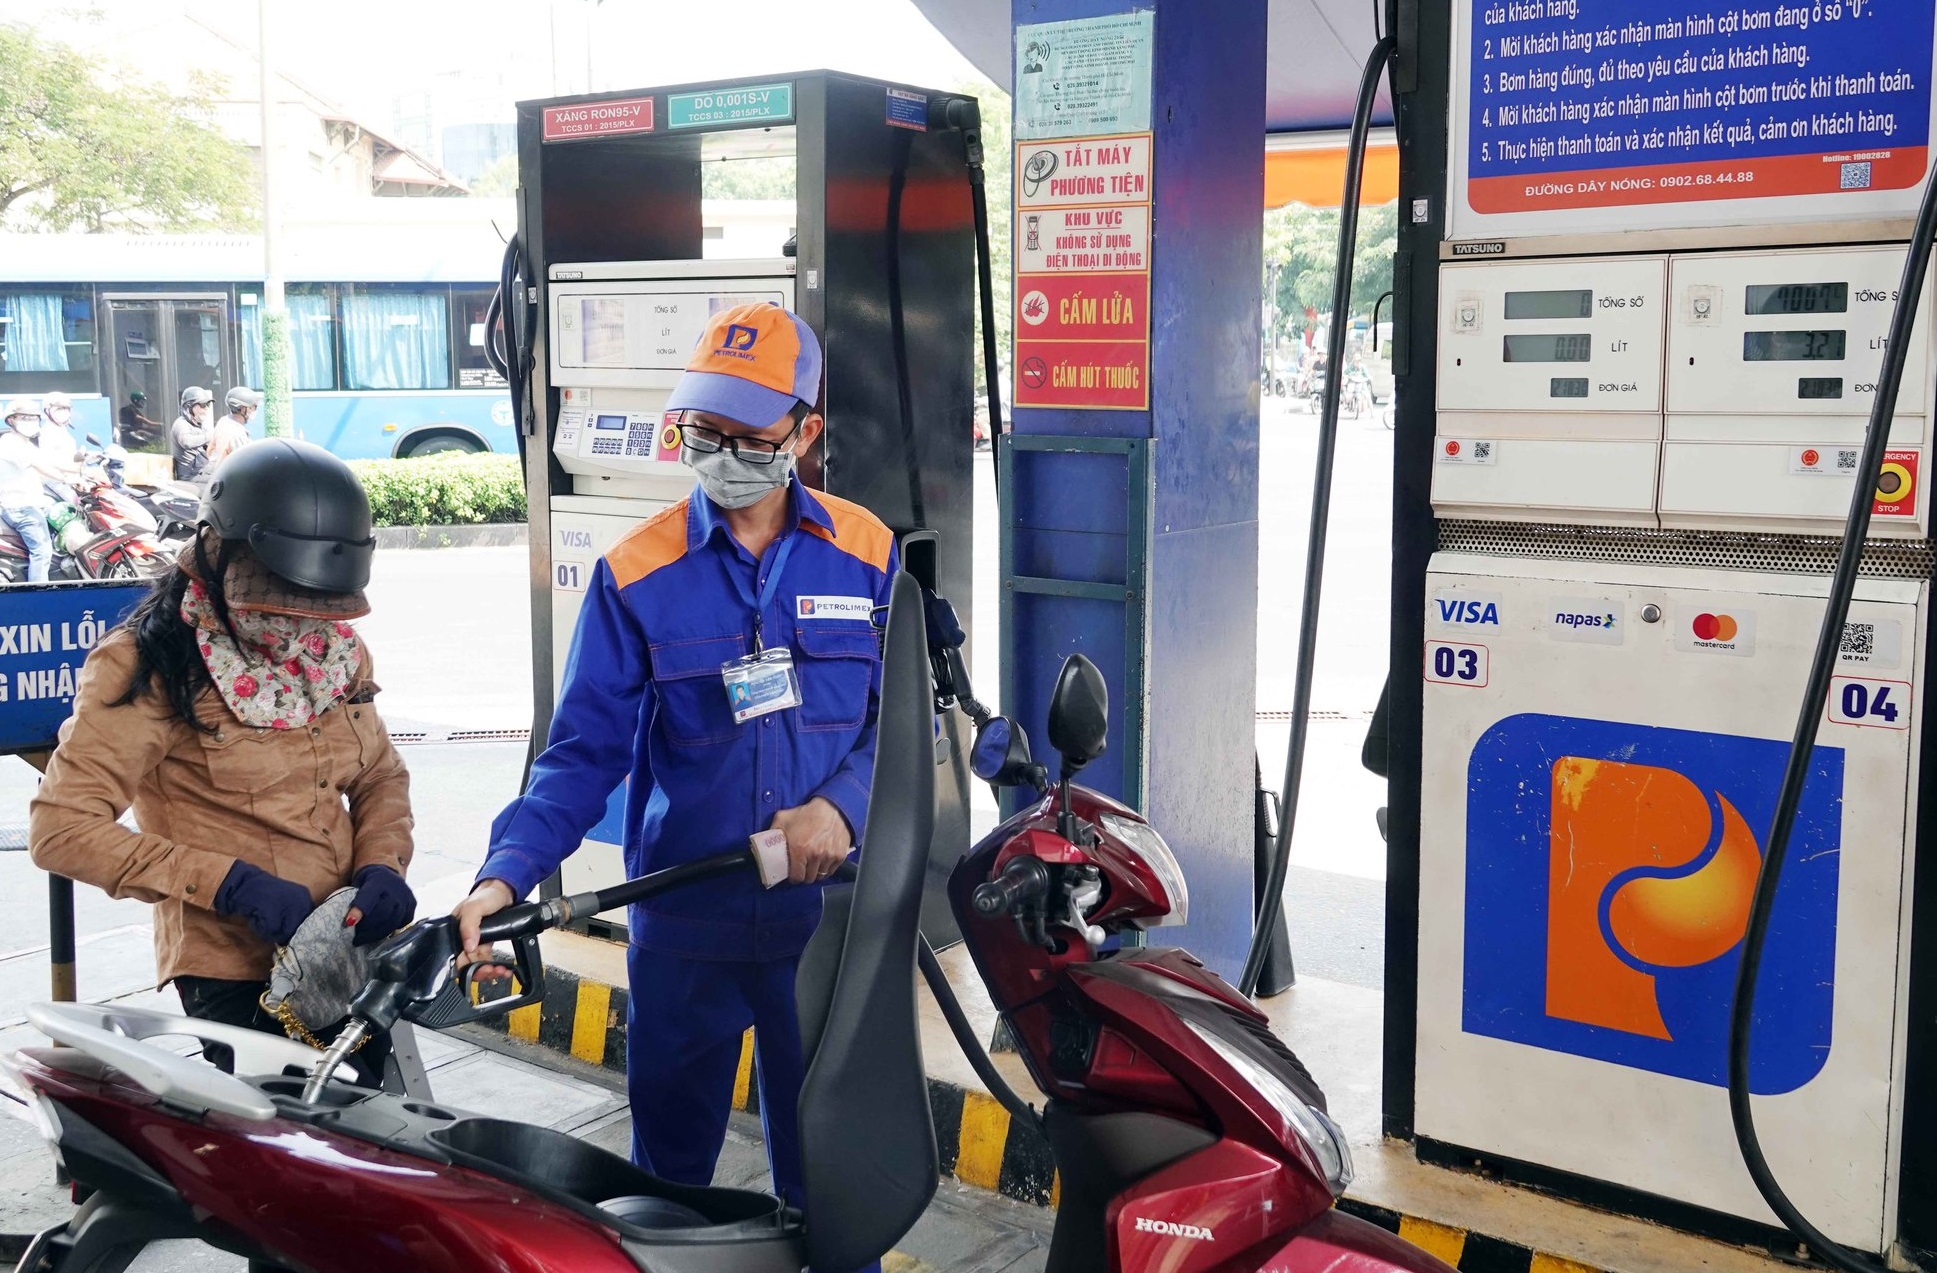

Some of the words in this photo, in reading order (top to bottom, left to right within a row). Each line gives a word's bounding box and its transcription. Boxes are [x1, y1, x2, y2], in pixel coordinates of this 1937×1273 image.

[1485, 2, 1505, 25] của
[1509, 0, 1543, 22] khách
[1484, 39, 1494, 60] 2.
[1500, 36, 1520, 58] Mời
[1524, 31, 1558, 55] khách
[1562, 29, 1592, 53] hàng
[1596, 25, 1617, 48] xác
[1620, 21, 1650, 48] nhận
[1655, 18, 1682, 40] màn
[1686, 13, 1714, 37] hình
[1718, 11, 1738, 37] cột
[1742, 10, 1770, 31] bơm
[1775, 5, 1809, 30] đang
[1484, 74, 1494, 94] 3.
[1500, 72, 1526, 92] Bơm
[1529, 68, 1558, 92] hàng
[1561, 64, 1595, 88] đúng,
[1599, 59, 1614, 82] đủ
[1618, 59, 1644, 80] theo
[1648, 56, 1670, 82] yêu
[1674, 50, 1698, 74] cầu
[1701, 48, 1724, 72] của
[1728, 44, 1768, 69] khách
[1772, 42, 1810, 67] hàng.
[694, 98, 713, 109] DO
[716, 91, 770, 108] 0,001S-V
[1482, 108, 1492, 128] 4.
[1499, 105, 1519, 127] Mời
[1522, 102, 1557, 125] khách
[1560, 100, 1590, 124] hàng
[1594, 96, 1615, 118] xác
[1618, 93, 1648, 119] nhận
[1652, 90, 1680, 112] màn
[1684, 87, 1712, 109] hình
[1716, 86, 1736, 111] cột
[1740, 84, 1768, 105] bơm
[1772, 78, 1806, 102] trước
[1810, 76, 1831, 98] khi
[1836, 73, 1876, 96] thanh
[1880, 68, 1915, 92] toán.
[556, 110, 588, 123] XĂNG
[592, 106, 641, 120] RON95-V
[688, 112, 712, 122] TCCS
[731, 107, 770, 118] 2015/PLX
[562, 125, 582, 133] TCCS
[600, 120, 635, 130] 2015/PLX
[1482, 142, 1492, 162] 5.
[1499, 140, 1526, 164] Thực
[1530, 137, 1554, 162] hiện
[1558, 134, 1592, 156] thanh
[1595, 130, 1621, 152] toán
[1625, 129, 1639, 151] và
[1642, 127, 1664, 150] xác
[1668, 124, 1700, 150] nhận
[1704, 120, 1724, 145] kết
[1727, 118, 1755, 148] quả,
[1759, 116, 1787, 140] cảm
[1791, 121, 1808, 138] ơn
[1812, 111, 1854, 136] khách
[1858, 109, 1898, 136] hàng.
[1065, 144, 1092, 167] TẮT
[1098, 144, 1132, 166] MÁY
[1822, 155, 1852, 163] Hotline:
[1853, 151, 1890, 162] 19002828
[1050, 175, 1105, 196] PHƯƠNG
[1111, 172, 1144, 196] TIỆN
[1525, 180, 1574, 196] ĐƯỜNG
[1578, 179, 1606, 194] DÂY
[1610, 176, 1656, 190] NÓNG:
[1660, 172, 1754, 188] 0902.68.44.88
[1065, 213, 1091, 226] KHU
[1096, 210, 1122, 228] VỰC
[1056, 234, 1086, 250] KHÔNG
[1090, 232, 1102, 248] SỬ
[1106, 234, 1132, 250] DỤNG
[1455, 244, 1503, 254] TATSUNO
[1046, 252, 1068, 270] ĐIỆN
[1072, 254, 1100, 270] THOẠI
[1103, 254, 1112, 266] DI
[1116, 250, 1142, 269] ĐỘNG
[1598, 296, 1626, 308] TỔNG
[1630, 295, 1644, 308] SỐ
[1855, 289, 1887, 302] TỔNG
[1891, 291, 1899, 301] S
[1060, 290, 1098, 325] CẤM
[1102, 290, 1134, 325] LỬA
[662, 328, 671, 336] LÍT
[1611, 340, 1628, 352] LÍT
[1870, 336, 1888, 350] LÍT
[1052, 360, 1077, 388] CẤM
[1080, 362, 1102, 388] HÚT
[1105, 360, 1140, 389] THUỐC
[1599, 383, 1619, 392] ĐƠN
[1621, 382, 1638, 392] GIÁ
[560, 530, 592, 548] VISA
[558, 564, 578, 588] 01
[1434, 599, 1499, 625] VISA
[1556, 612, 1602, 628] napas
[0, 623, 52, 656] XIN
[61, 610, 106, 651] LỖI
[1694, 641, 1736, 650] mastercard
[1434, 646, 1478, 680] 03
[1842, 654, 1853, 662] QR
[1842, 683, 1898, 722] 04
[1135, 1217, 1215, 1242] HONDA
